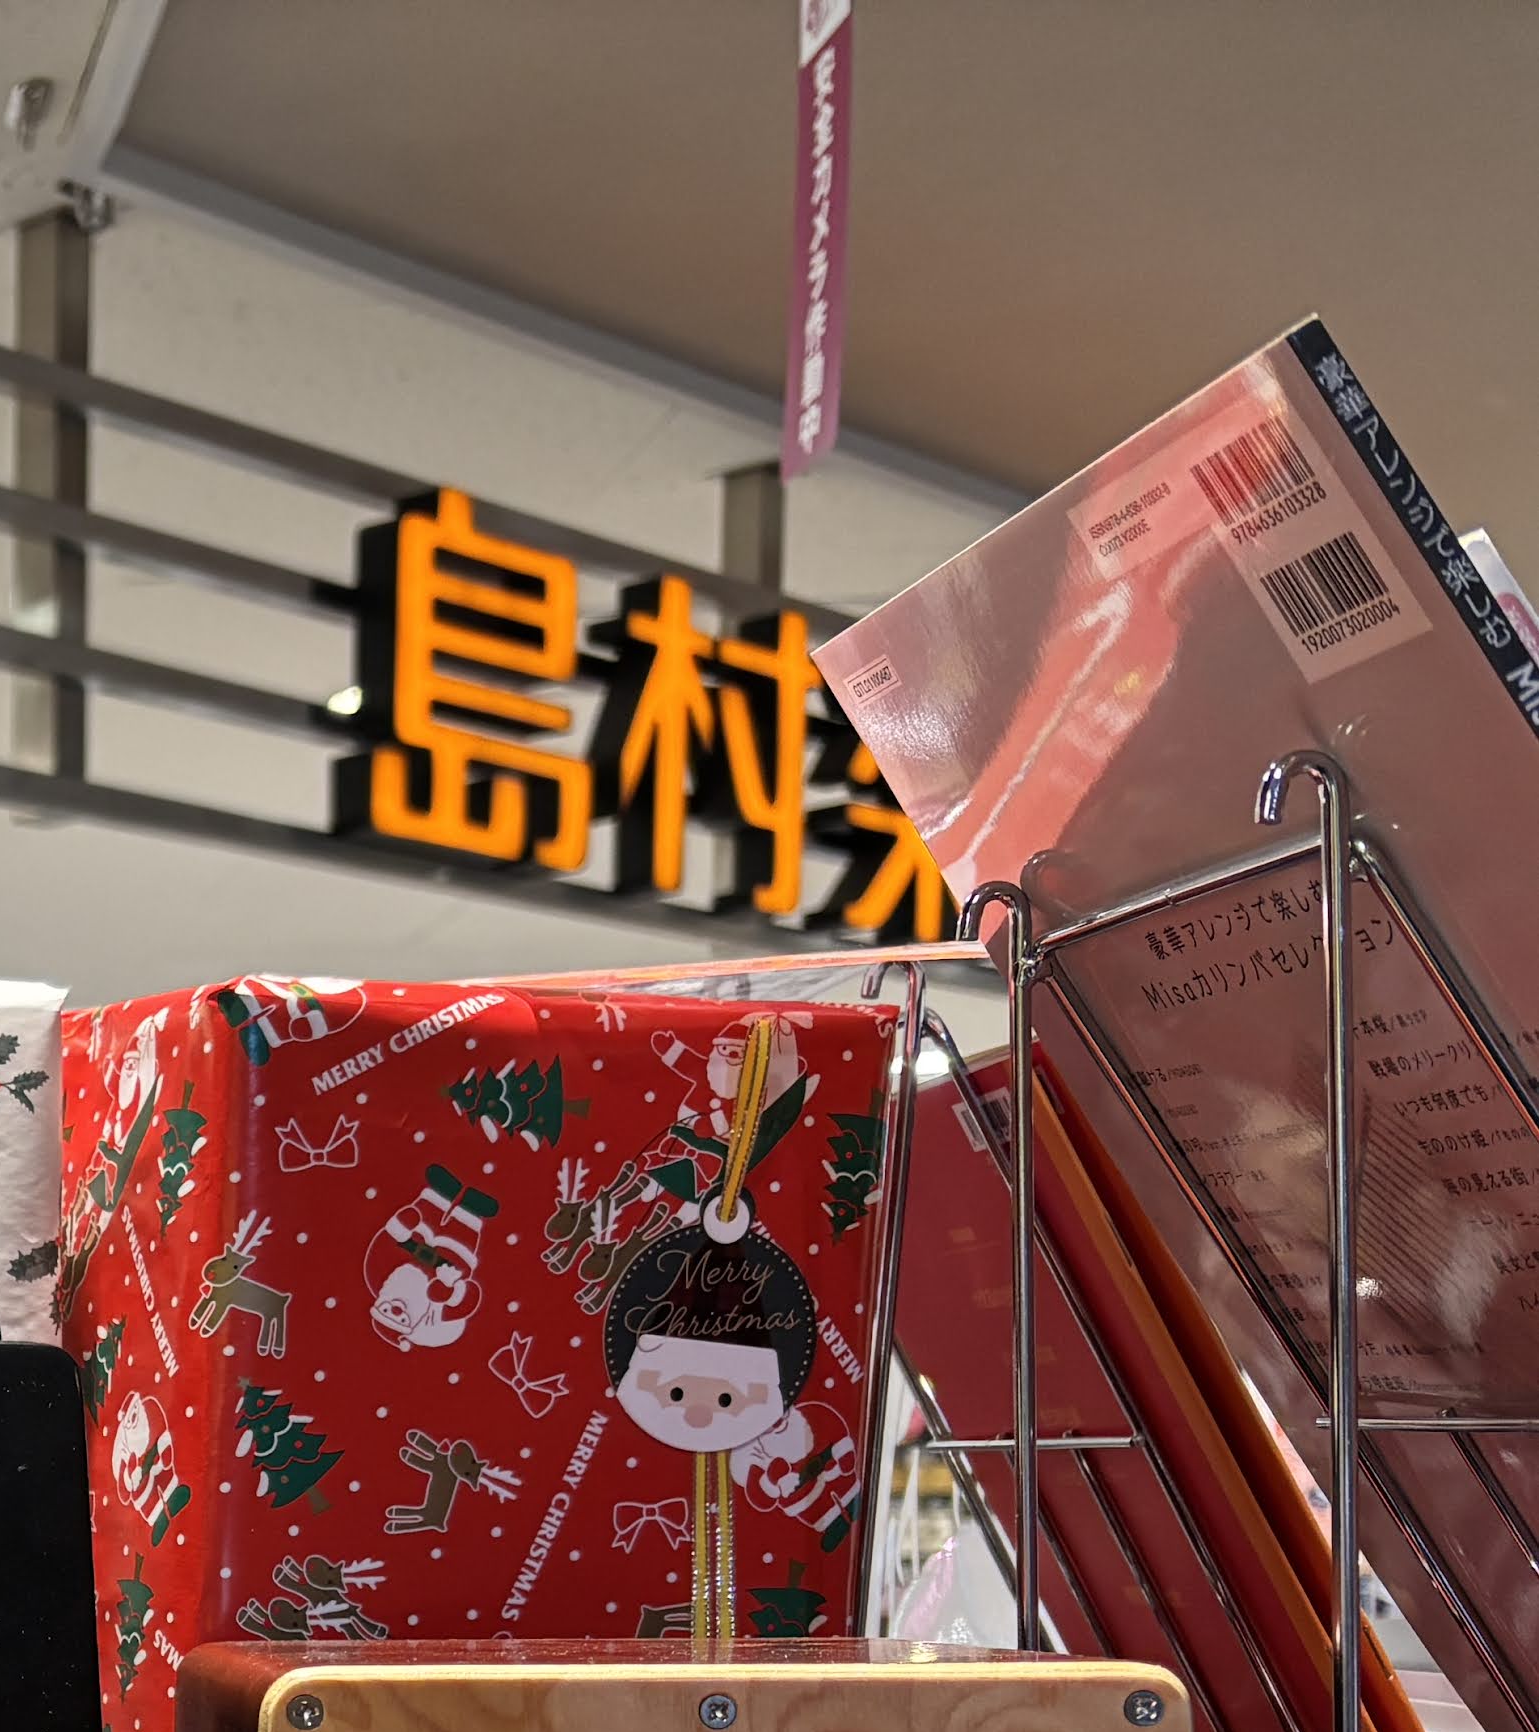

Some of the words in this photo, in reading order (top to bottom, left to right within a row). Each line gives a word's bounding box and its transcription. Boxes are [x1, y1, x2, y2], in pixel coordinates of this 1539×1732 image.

[1232, 482, 1327, 545] 9784636103328
[1301, 598, 1400, 656] 1920073020004
[311, 1043, 386, 1096] MERRY
[388, 991, 506, 1064] CHRISTMAS
[120, 1202, 165, 1314] CHRISTMAS
[648, 1252, 774, 1307] Merry
[150, 1314, 179, 1380] MERRY
[622, 1300, 804, 1344] Christmas
[815, 1314, 863, 1386] MERRY
[575, 1409, 609, 1478] MERRY
[502, 1474, 575, 1624] CHRISTMAS
